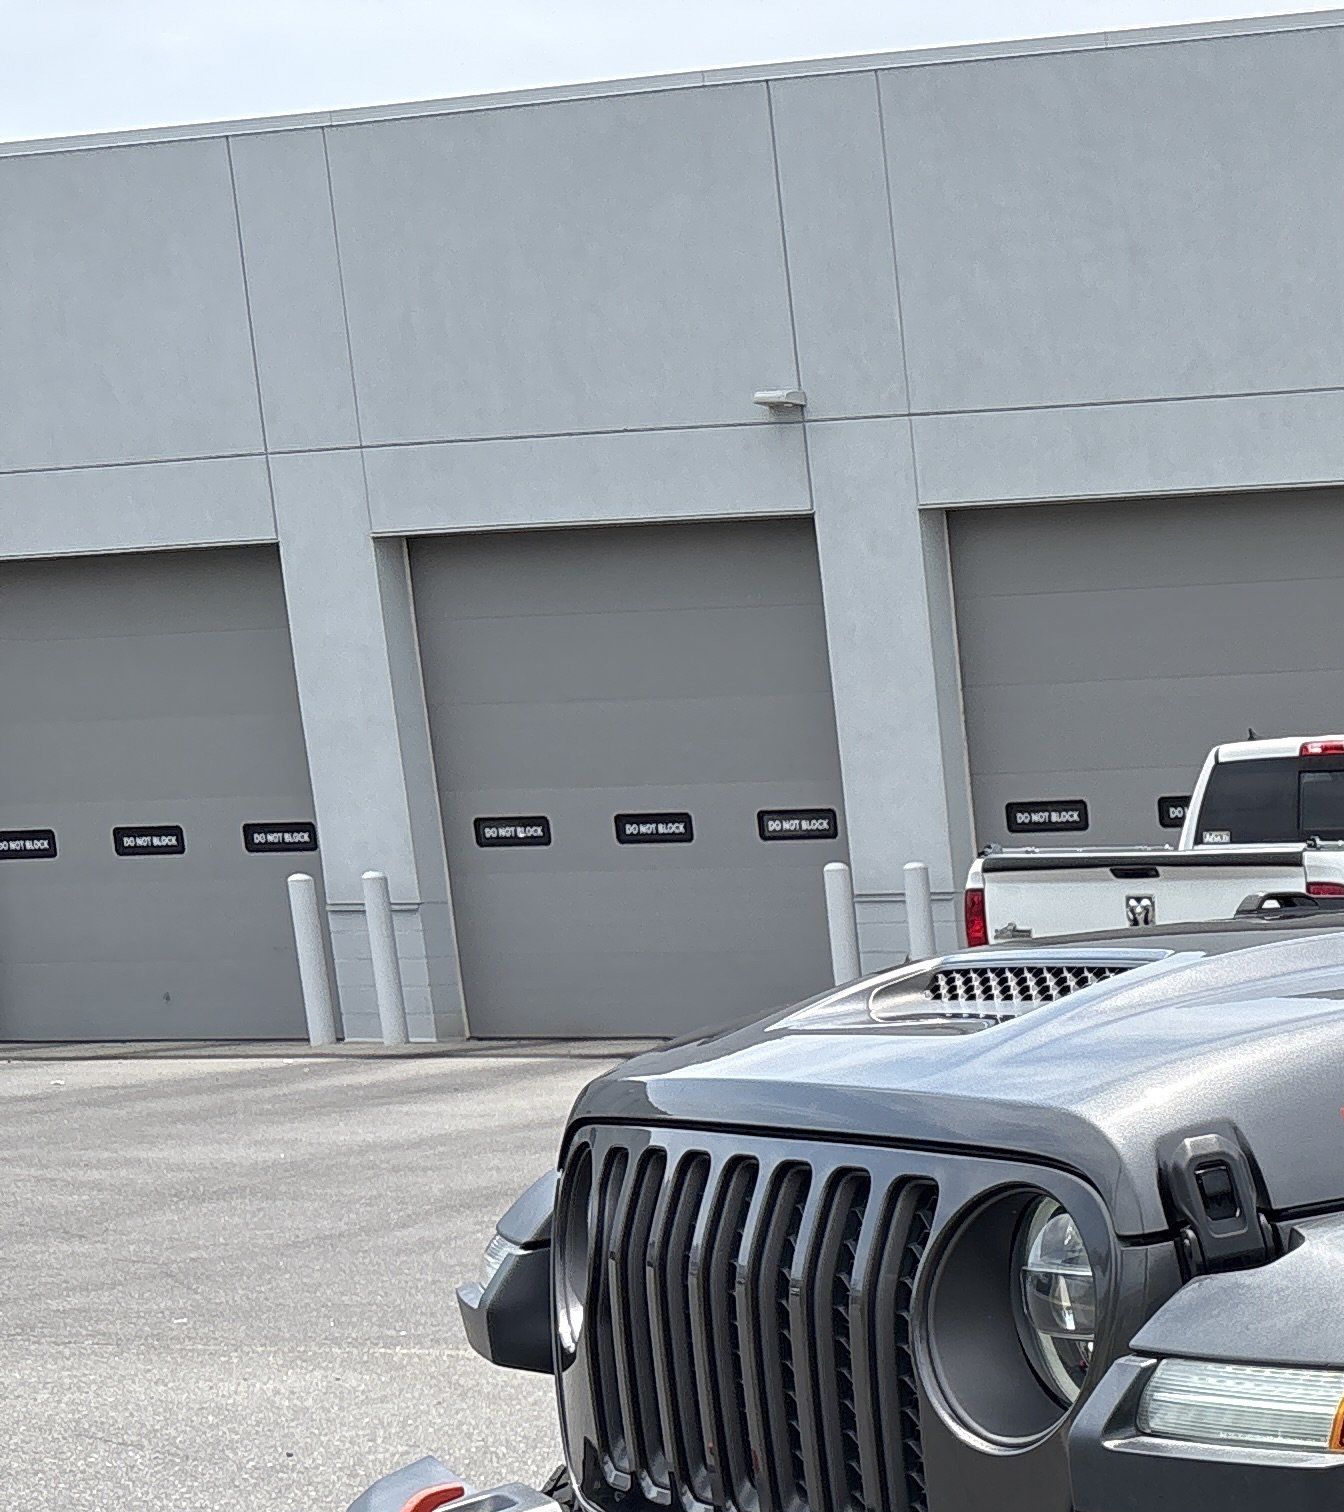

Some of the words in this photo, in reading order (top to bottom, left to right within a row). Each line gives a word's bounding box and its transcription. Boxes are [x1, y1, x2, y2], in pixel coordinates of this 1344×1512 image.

[1016, 812, 1030, 824] DO
[1031, 812, 1049, 823] NOT
[1050, 811, 1080, 823] BLOCK
[1169, 807, 1184, 818] DO
[625, 823, 639, 835] DO
[639, 823, 657, 834] NOT
[657, 822, 686, 834] BLOCK
[768, 820, 781, 831] DO
[782, 819, 800, 831] NOT
[801, 819, 830, 830] BLOCK
[253, 833, 266, 843] DO
[266, 832, 283, 843] NOT
[284, 832, 311, 843] BLOCK
[484, 827, 498, 838] DO
[498, 827, 515, 837] NOT
[516, 826, 543, 838] BLOCK
[9, 840, 25, 851] NOT
[25, 839, 50, 850] BLOCK
[123, 837, 135, 847] DO
[136, 836, 152, 847] NOT
[153, 835, 178, 847] BLOCK
